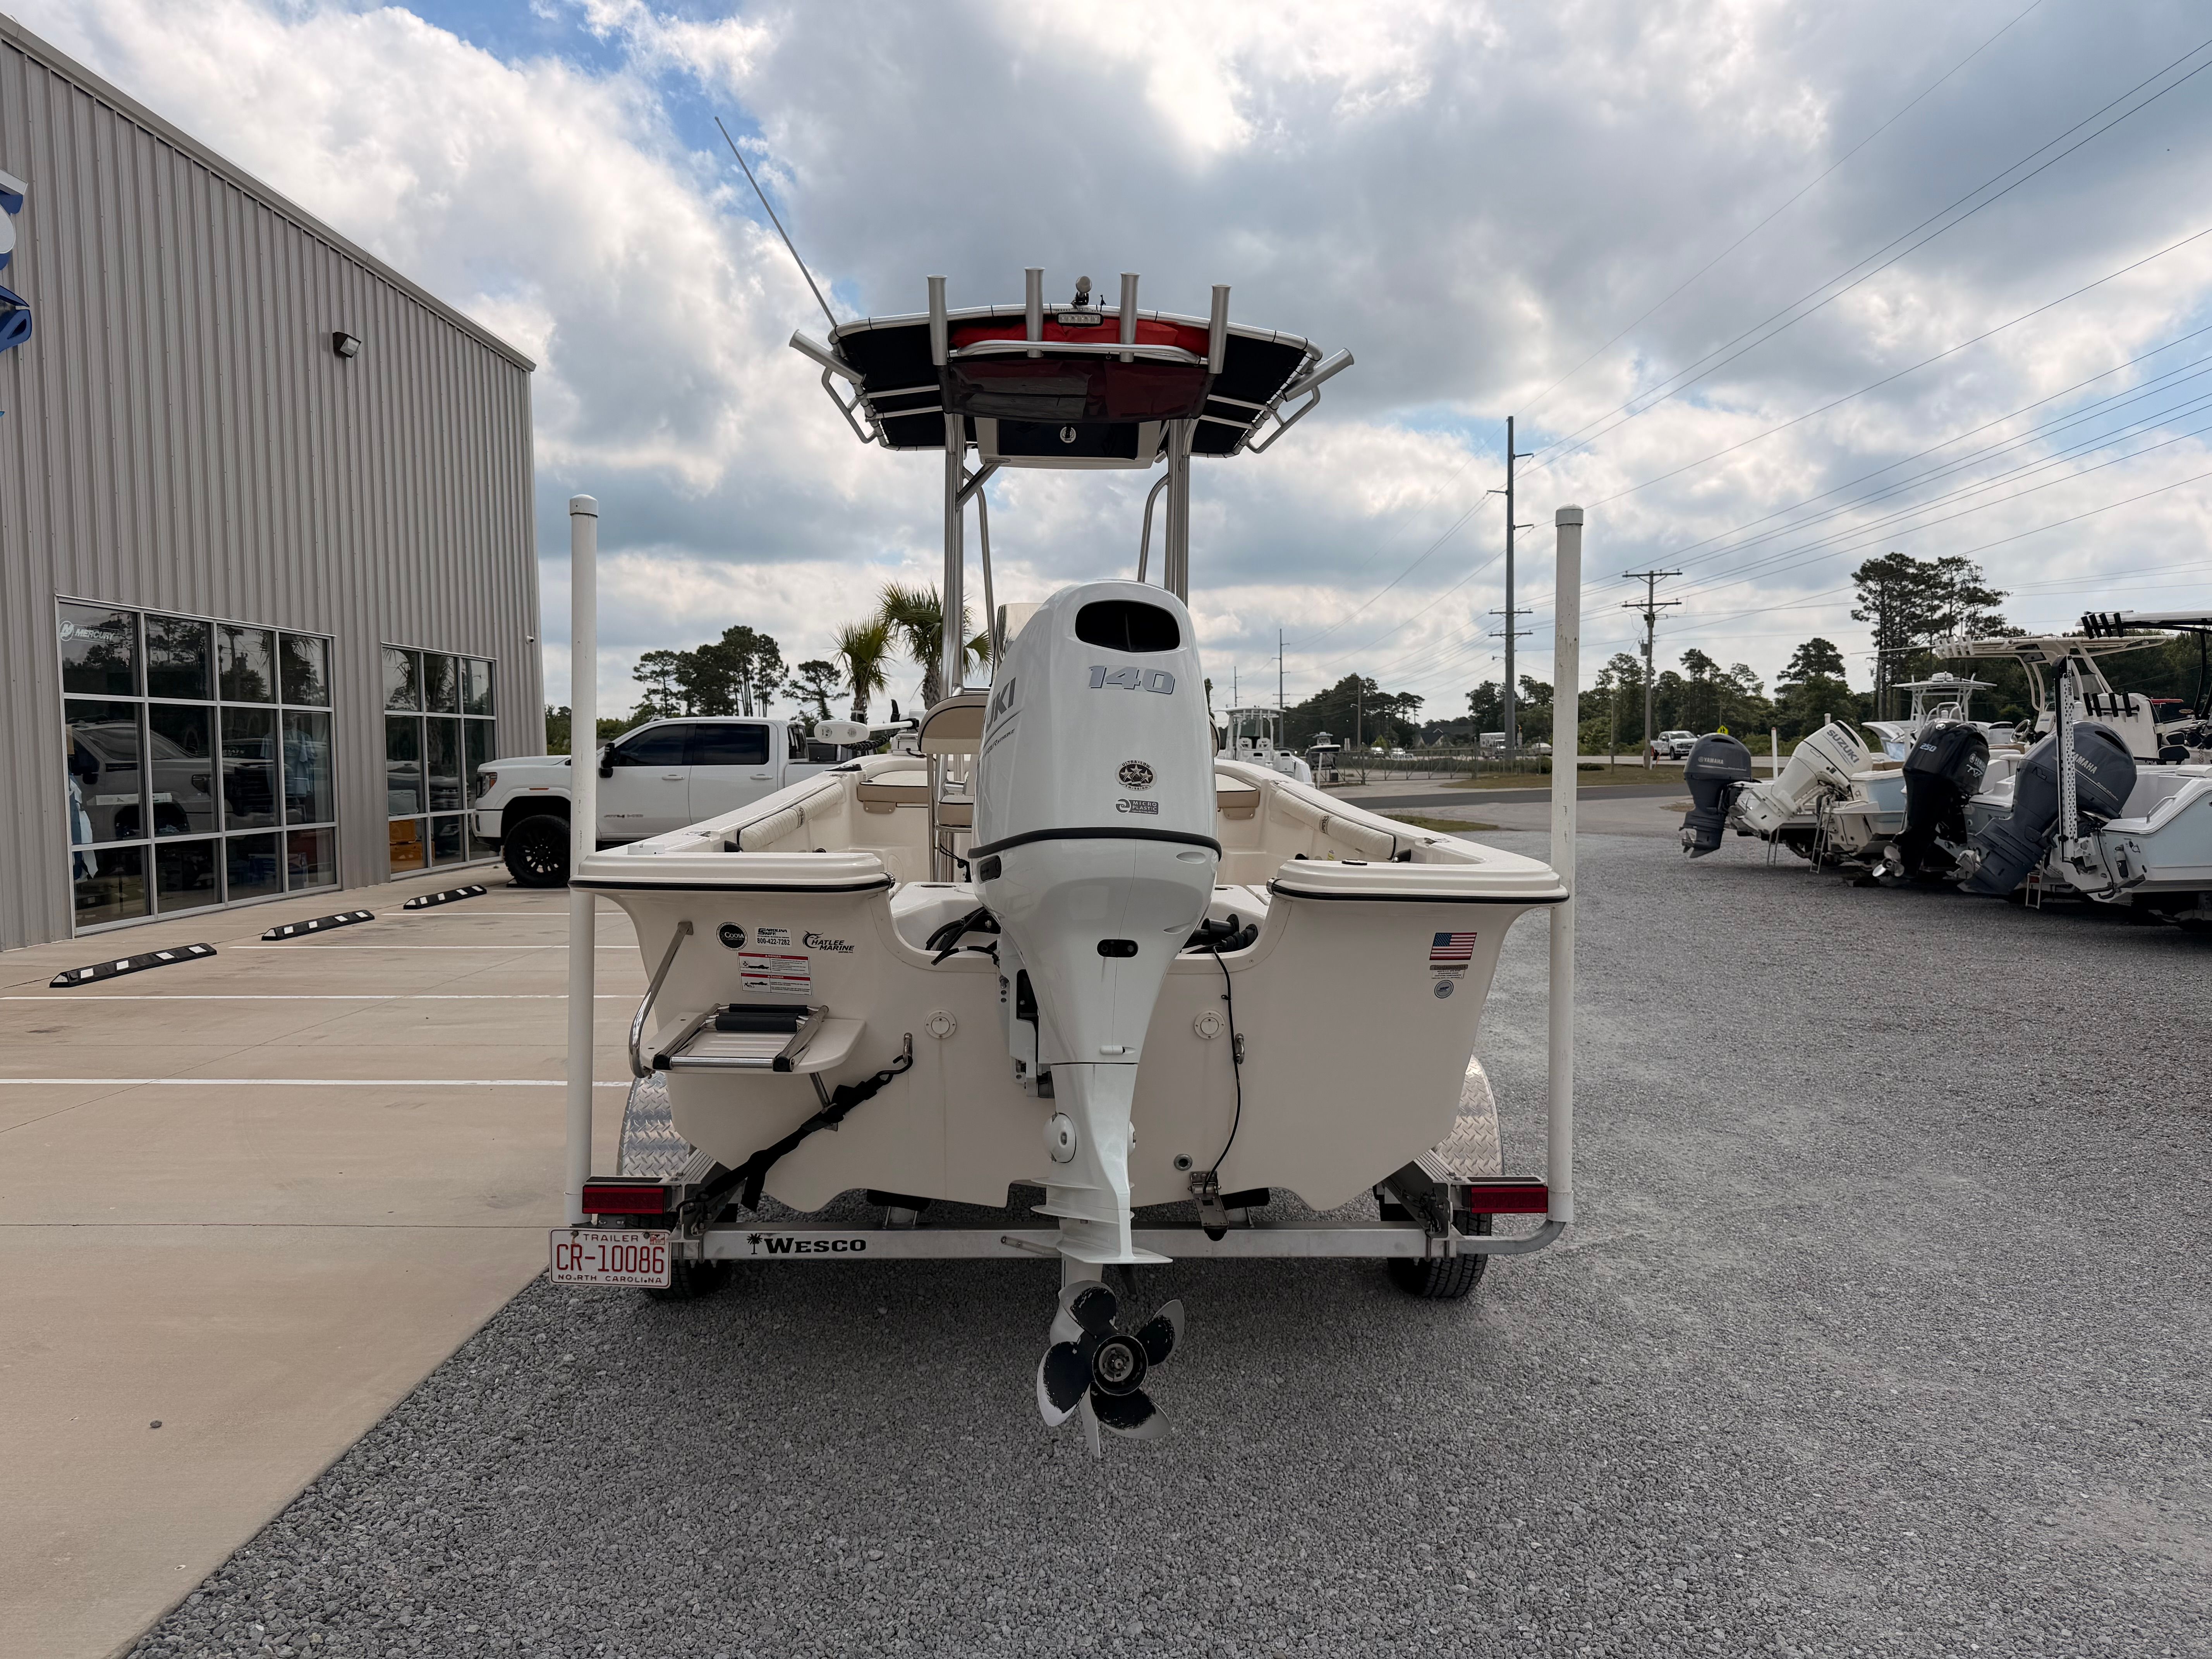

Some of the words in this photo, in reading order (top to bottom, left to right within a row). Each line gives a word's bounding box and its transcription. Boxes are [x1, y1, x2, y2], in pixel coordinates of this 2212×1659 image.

[75, 628, 115, 640] MERCURY
[1089, 665, 1175, 695] 140
[1827, 730, 1860, 763] SUZUKI
[1919, 743, 1937, 752] 250
[2073, 752, 2097, 774] AMAHA
[556, 1243, 665, 1274] CR-10086
